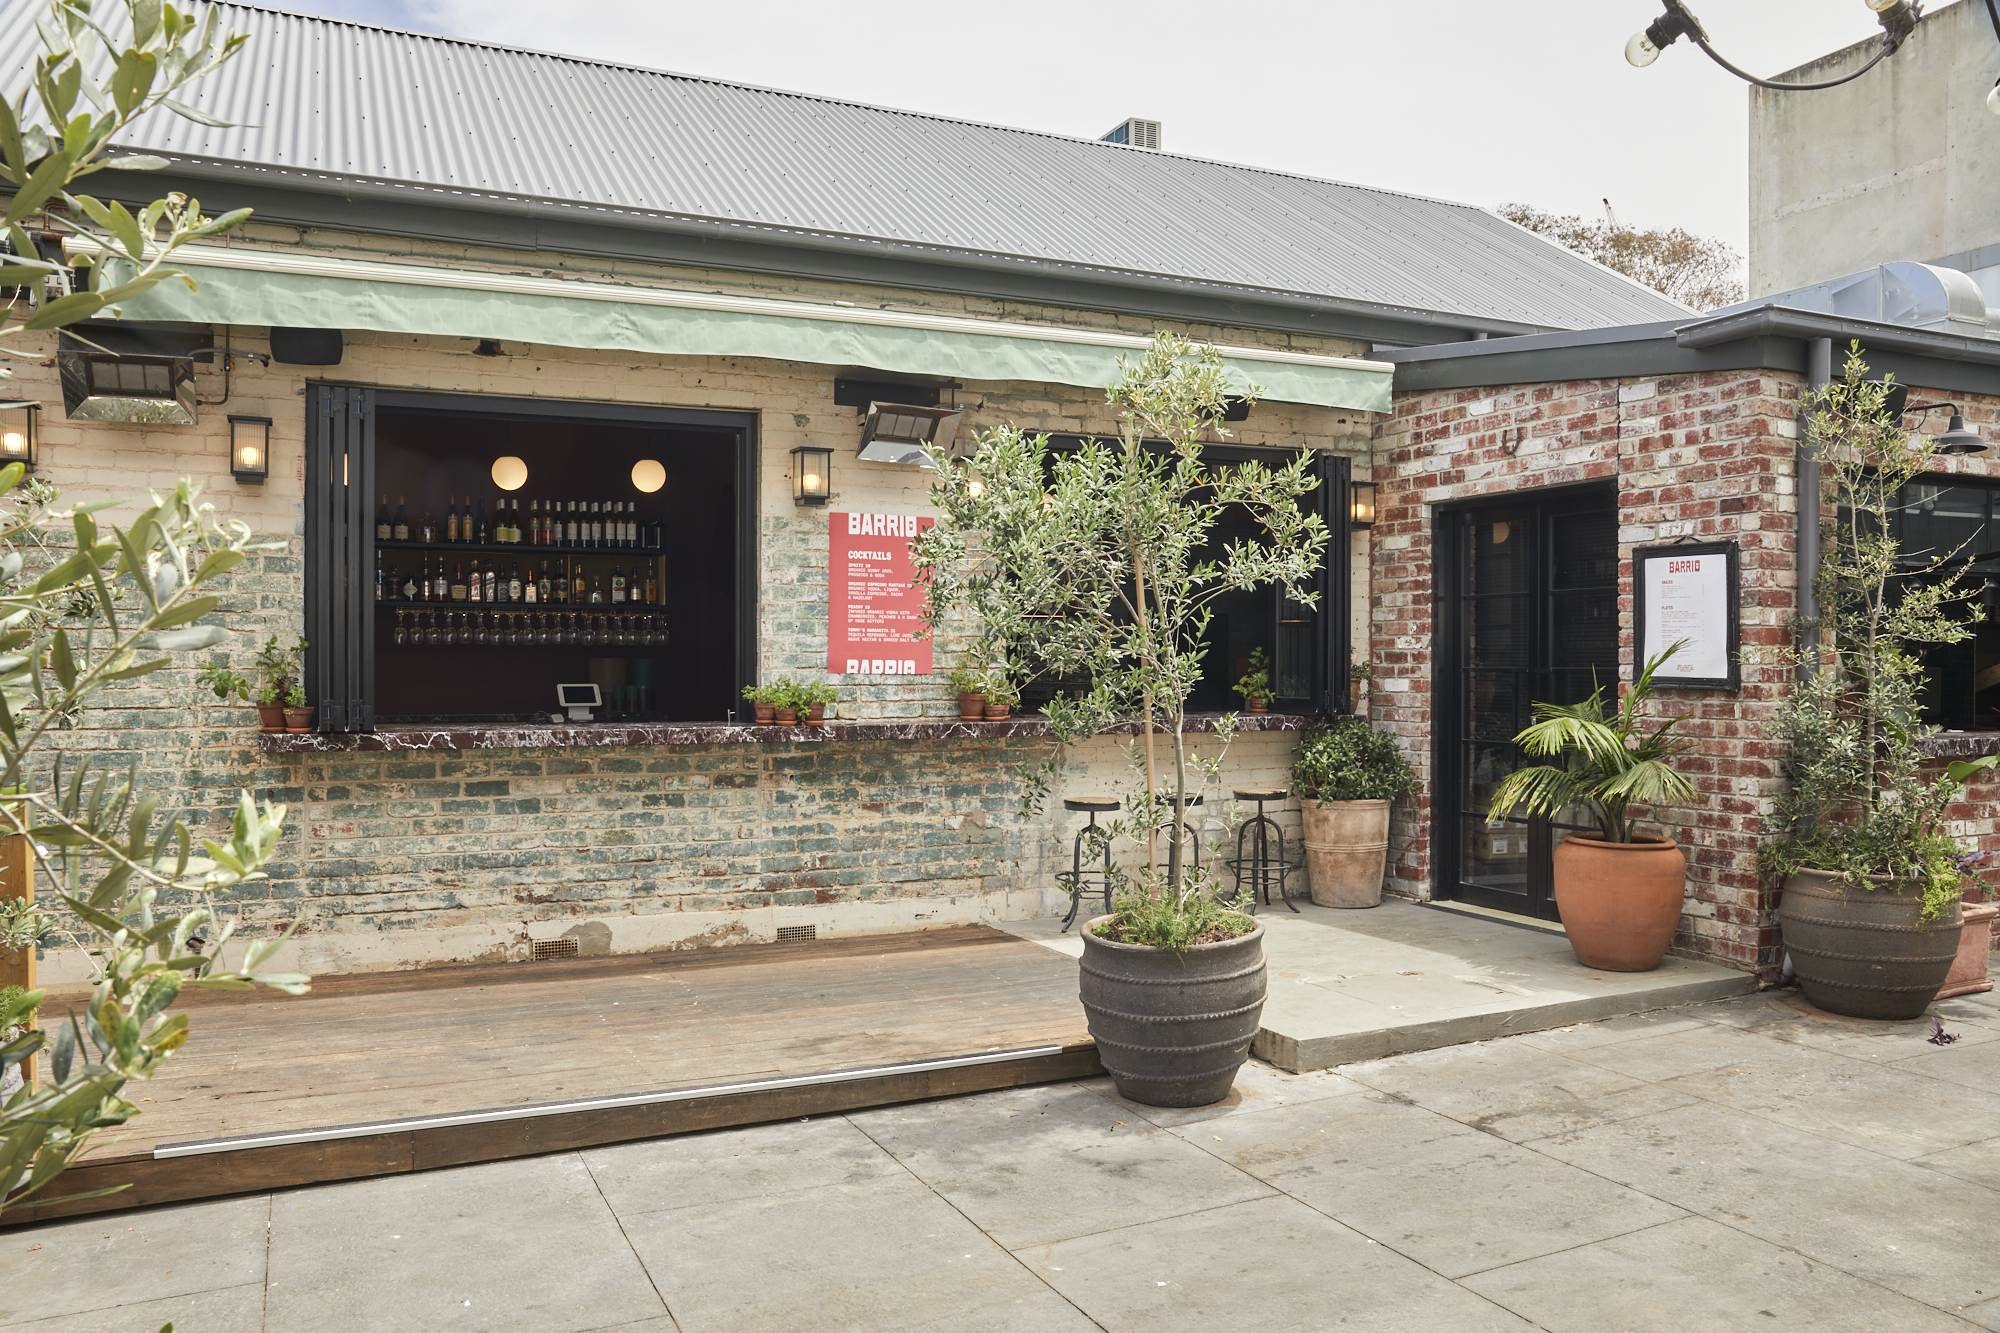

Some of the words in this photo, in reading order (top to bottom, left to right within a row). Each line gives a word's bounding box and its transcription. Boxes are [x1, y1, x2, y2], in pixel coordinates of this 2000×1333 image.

[848, 512, 917, 537] BARRIO
[848, 550, 892, 560] COCKTAILS
[1669, 560, 1700, 573] BARRIO
